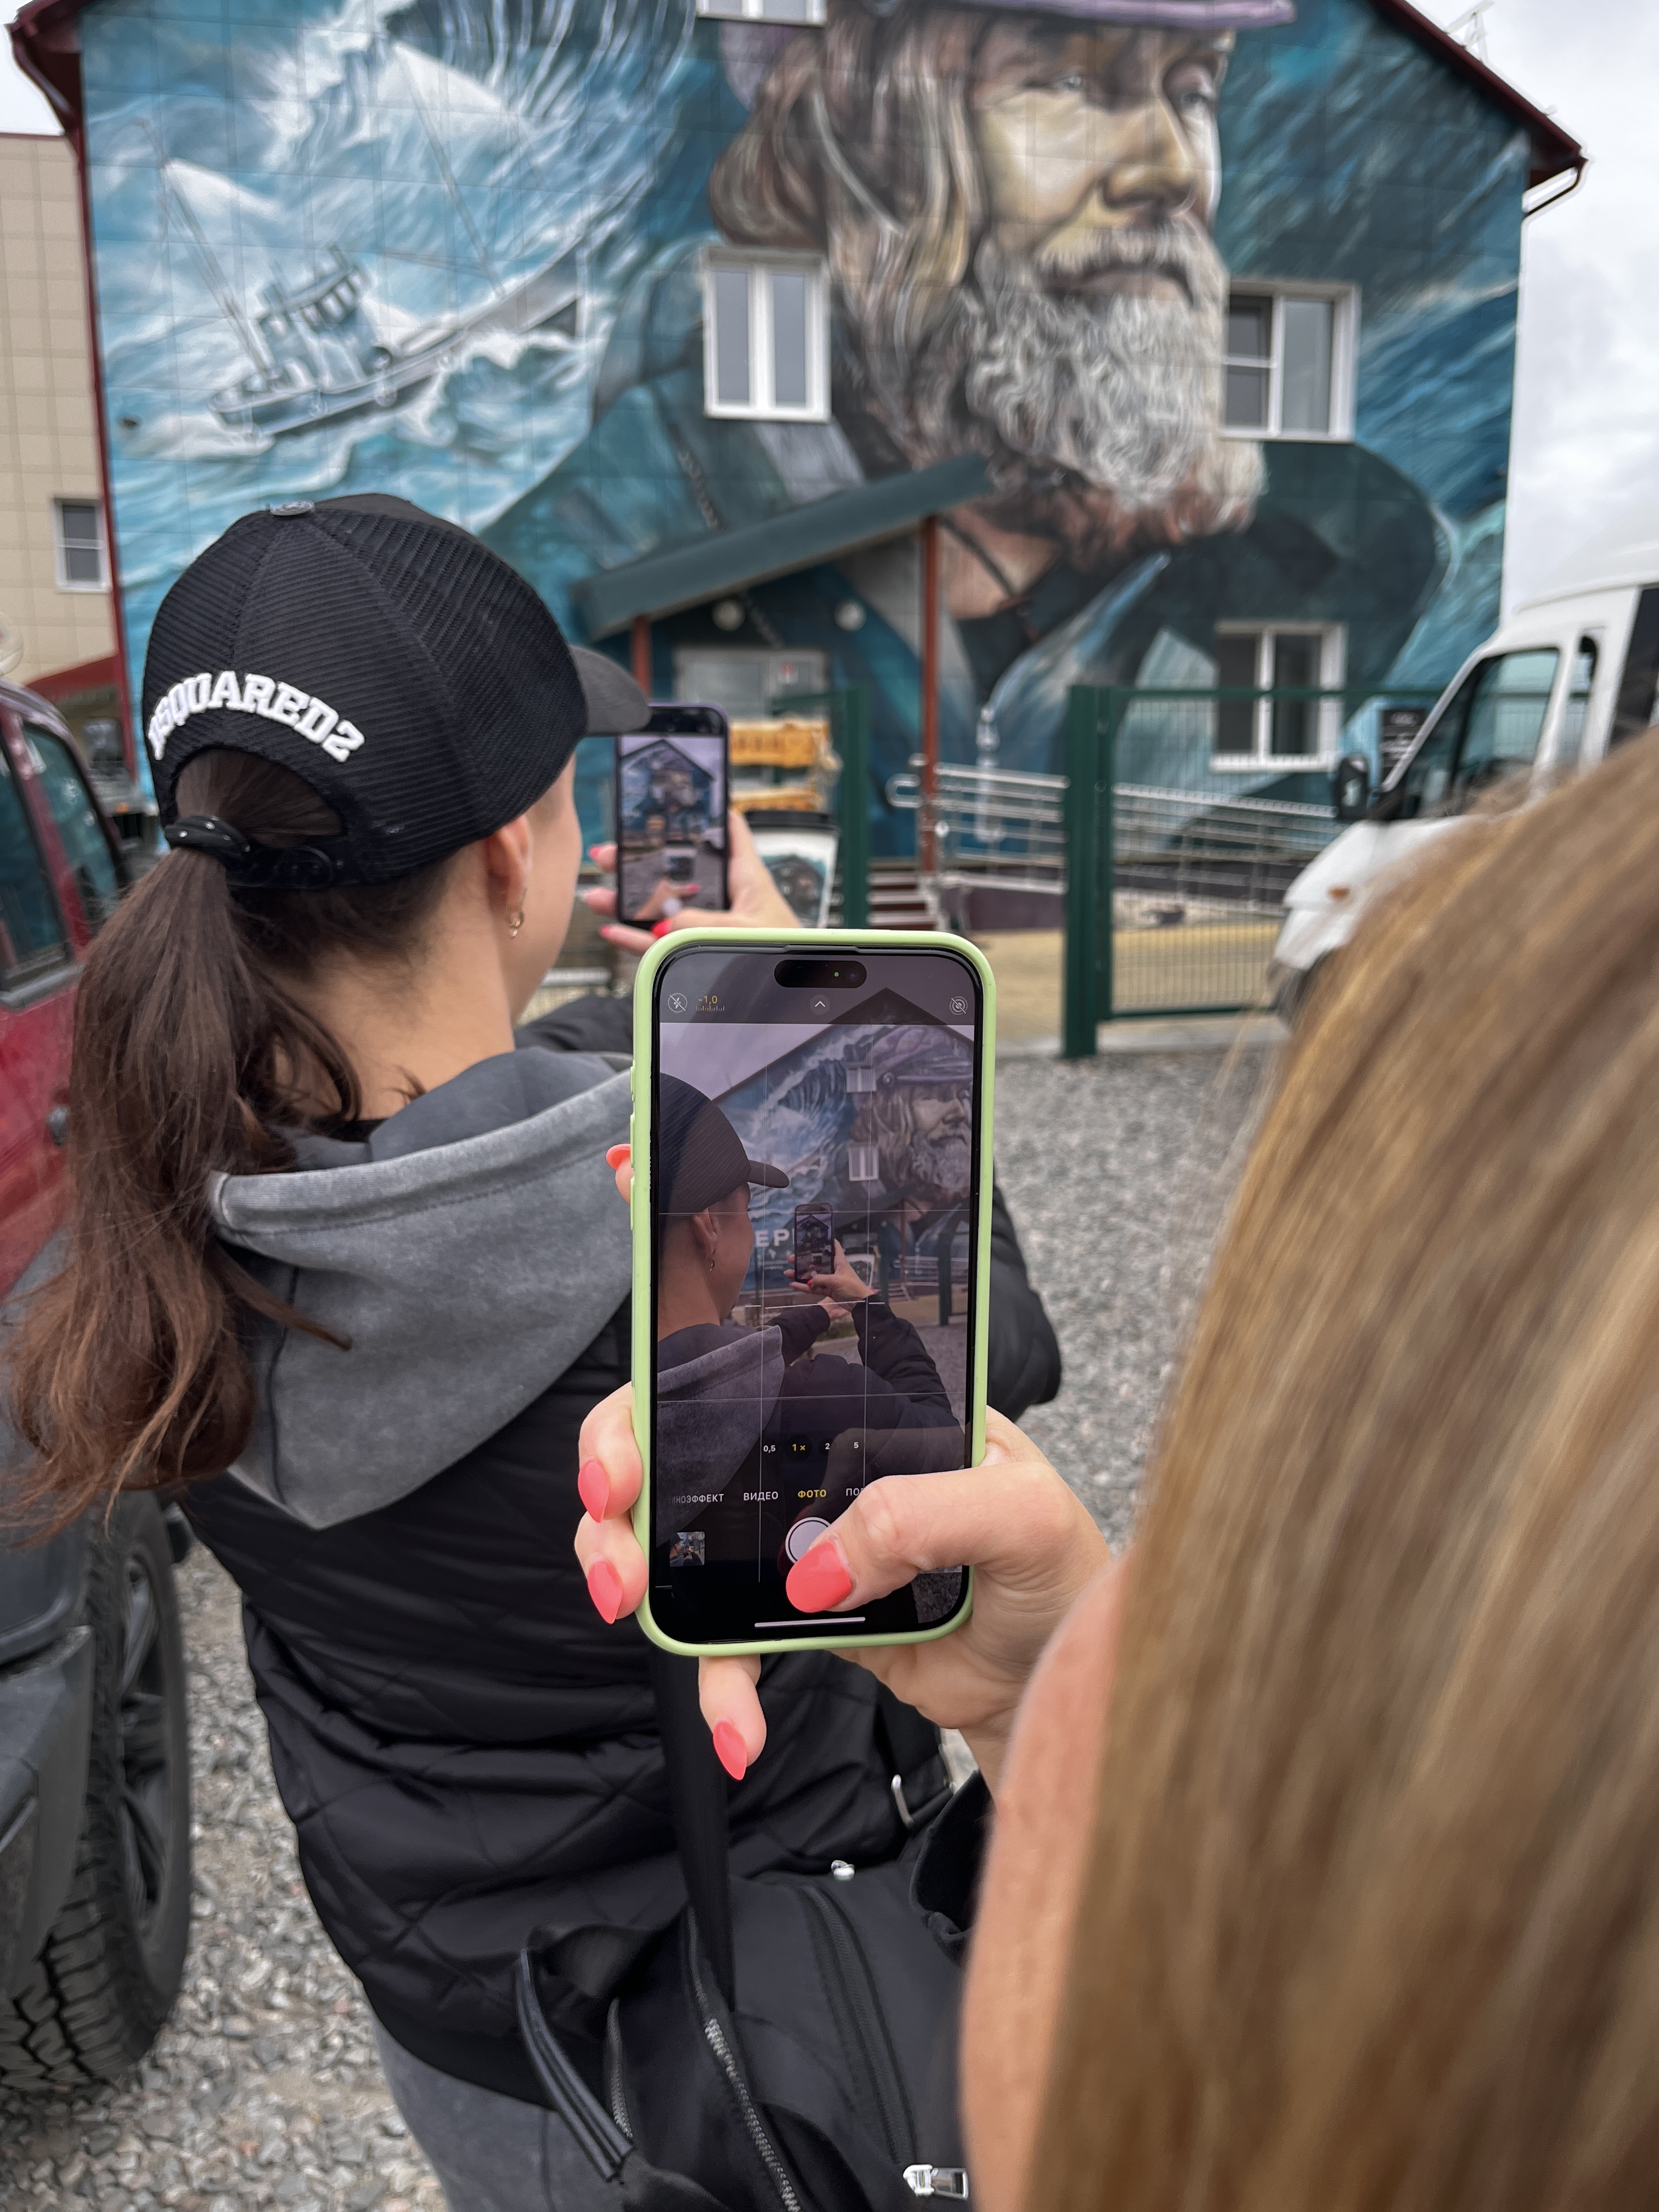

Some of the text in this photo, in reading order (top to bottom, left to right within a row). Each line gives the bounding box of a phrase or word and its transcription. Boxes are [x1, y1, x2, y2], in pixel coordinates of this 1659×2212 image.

[698, 995, 718, 1006] -1,0
[755, 1228, 795, 1247] ЕР
[763, 1445, 776, 1453] 0,5
[743, 1491, 778, 1502] ВИДЕО
[798, 1489, 827, 1498] ФОТО
